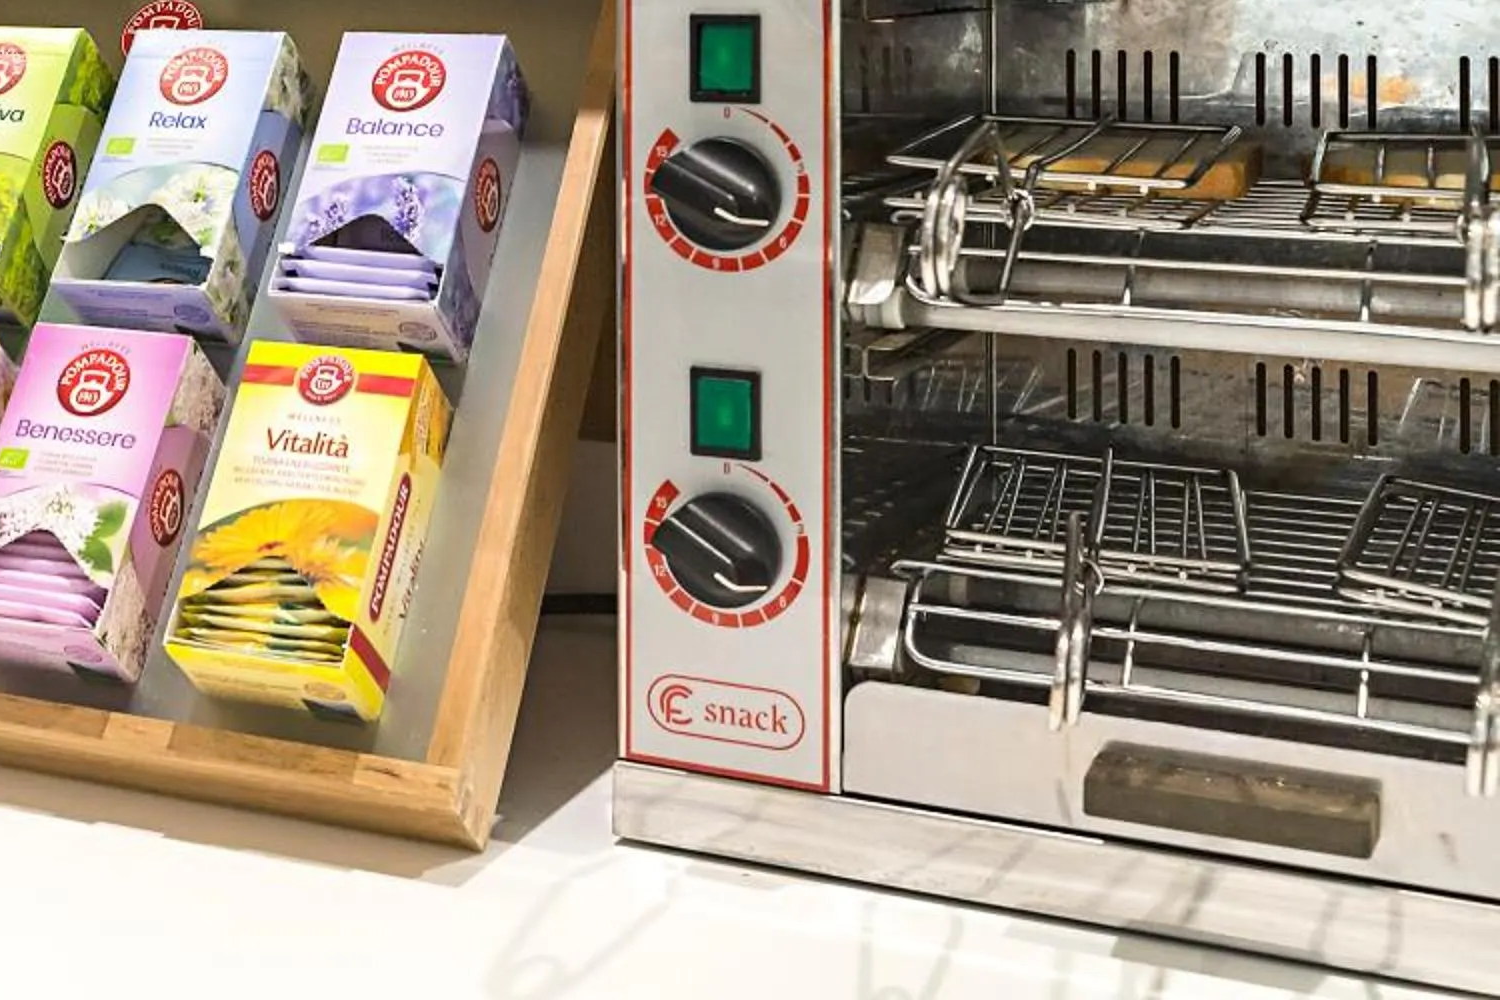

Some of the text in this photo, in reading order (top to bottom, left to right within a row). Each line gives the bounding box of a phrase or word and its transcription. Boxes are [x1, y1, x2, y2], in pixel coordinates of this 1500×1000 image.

[374, 53, 442, 88] POMPADOUR
[148, 111, 208, 129] Relax
[346, 117, 445, 137] Balance
[60, 352, 127, 391] POMPADOUR
[15, 418, 136, 449] Benessere
[267, 427, 349, 459] Vitalità
[371, 483, 410, 614] POMPADOUR
[703, 701, 788, 735] snack
